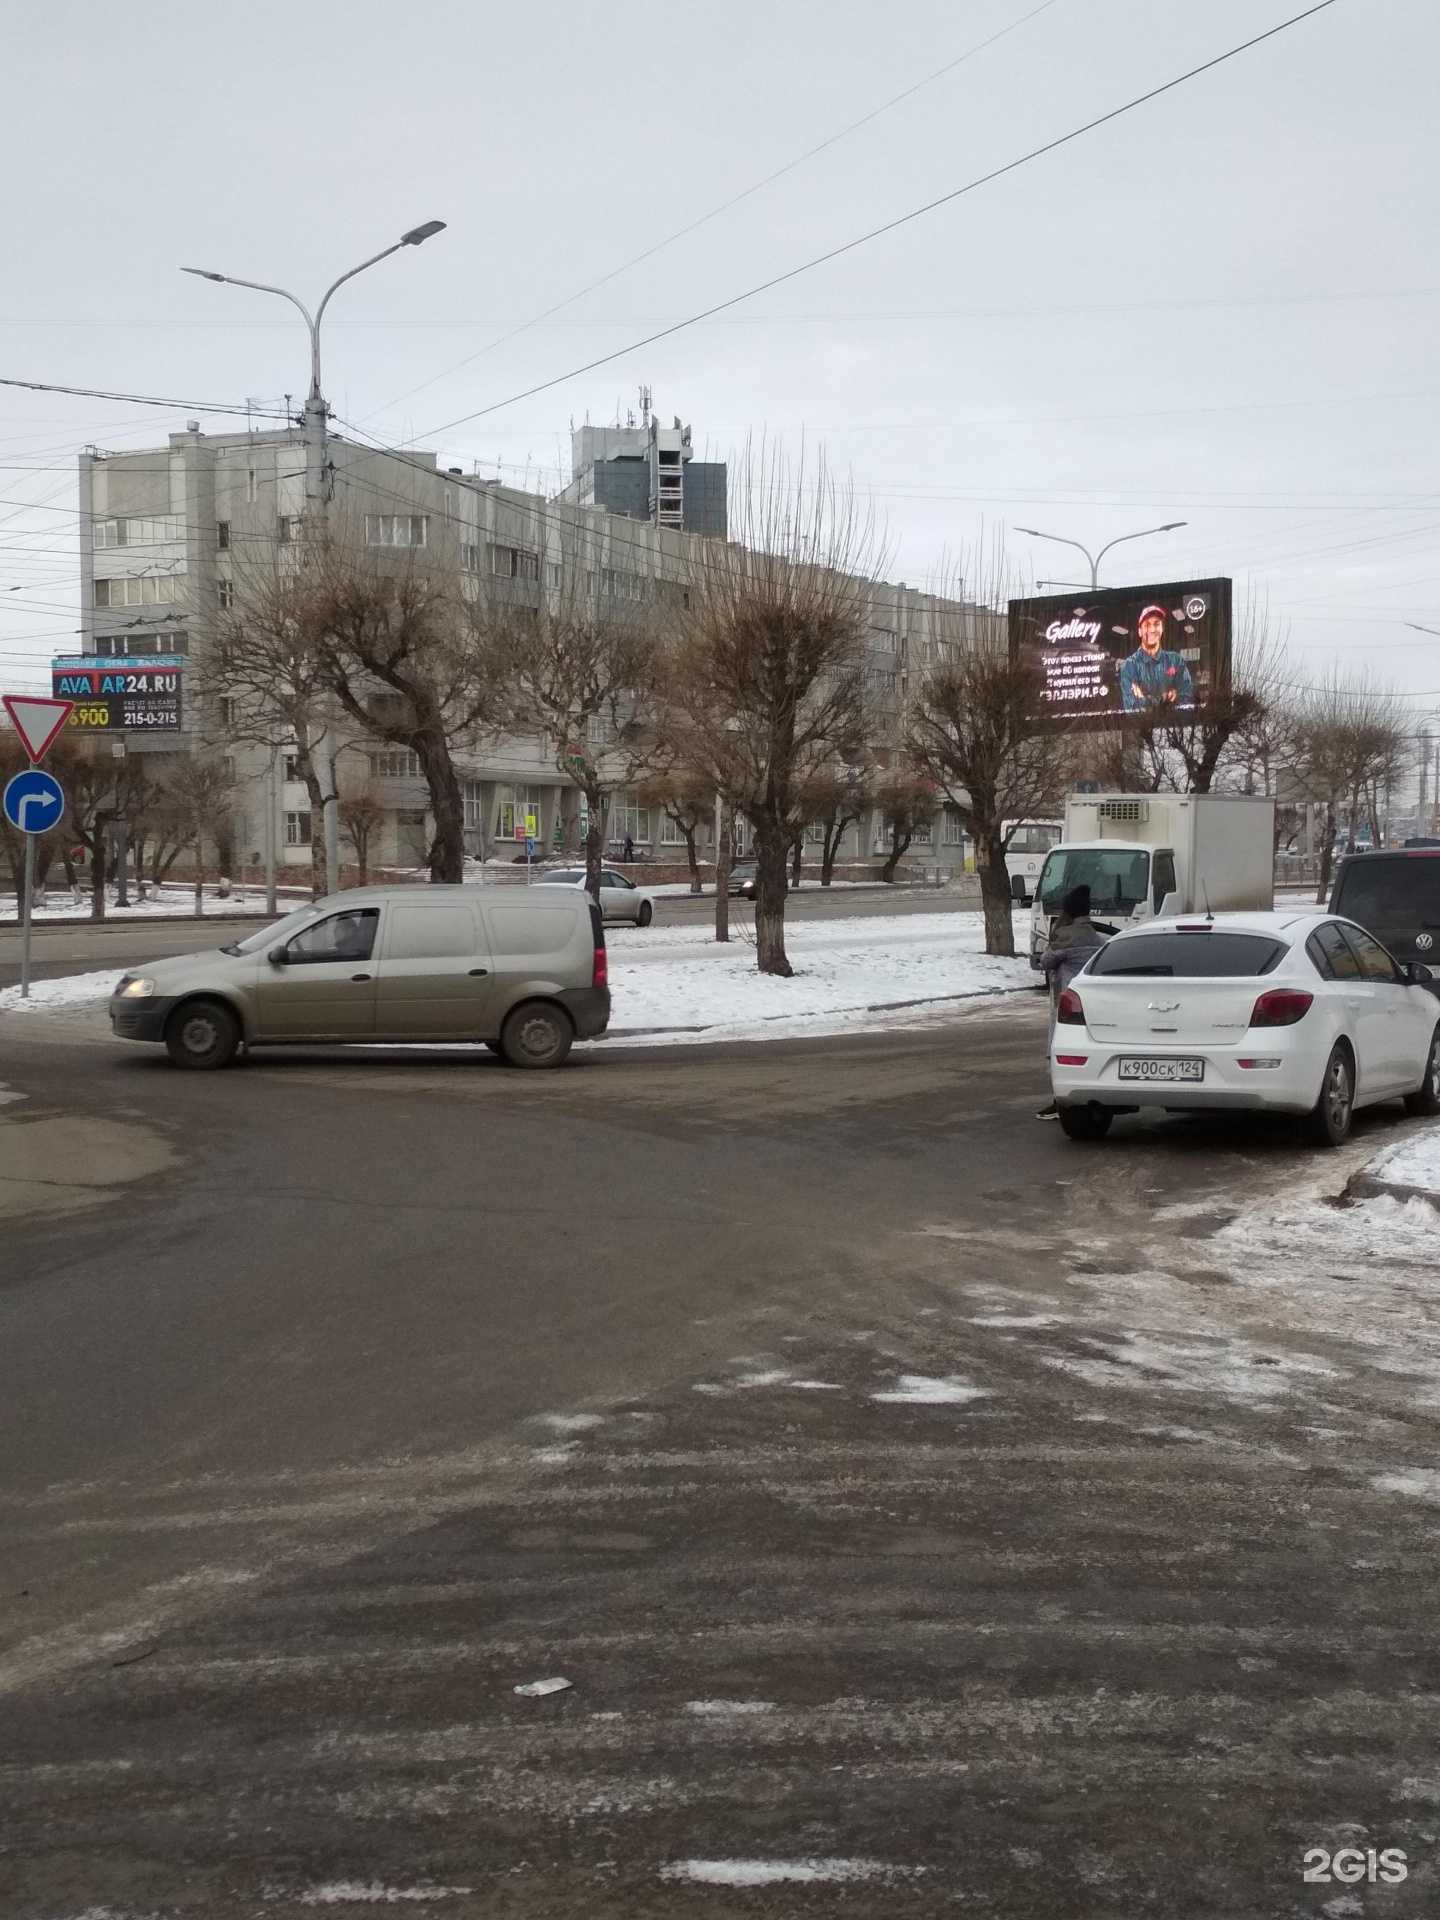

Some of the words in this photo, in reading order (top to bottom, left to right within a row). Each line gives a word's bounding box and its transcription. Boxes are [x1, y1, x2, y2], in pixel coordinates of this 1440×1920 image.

[1046, 618, 1102, 644] Gallery
[124, 712, 177, 725] 215-0-215
[1178, 1061, 1200, 1074] 124
